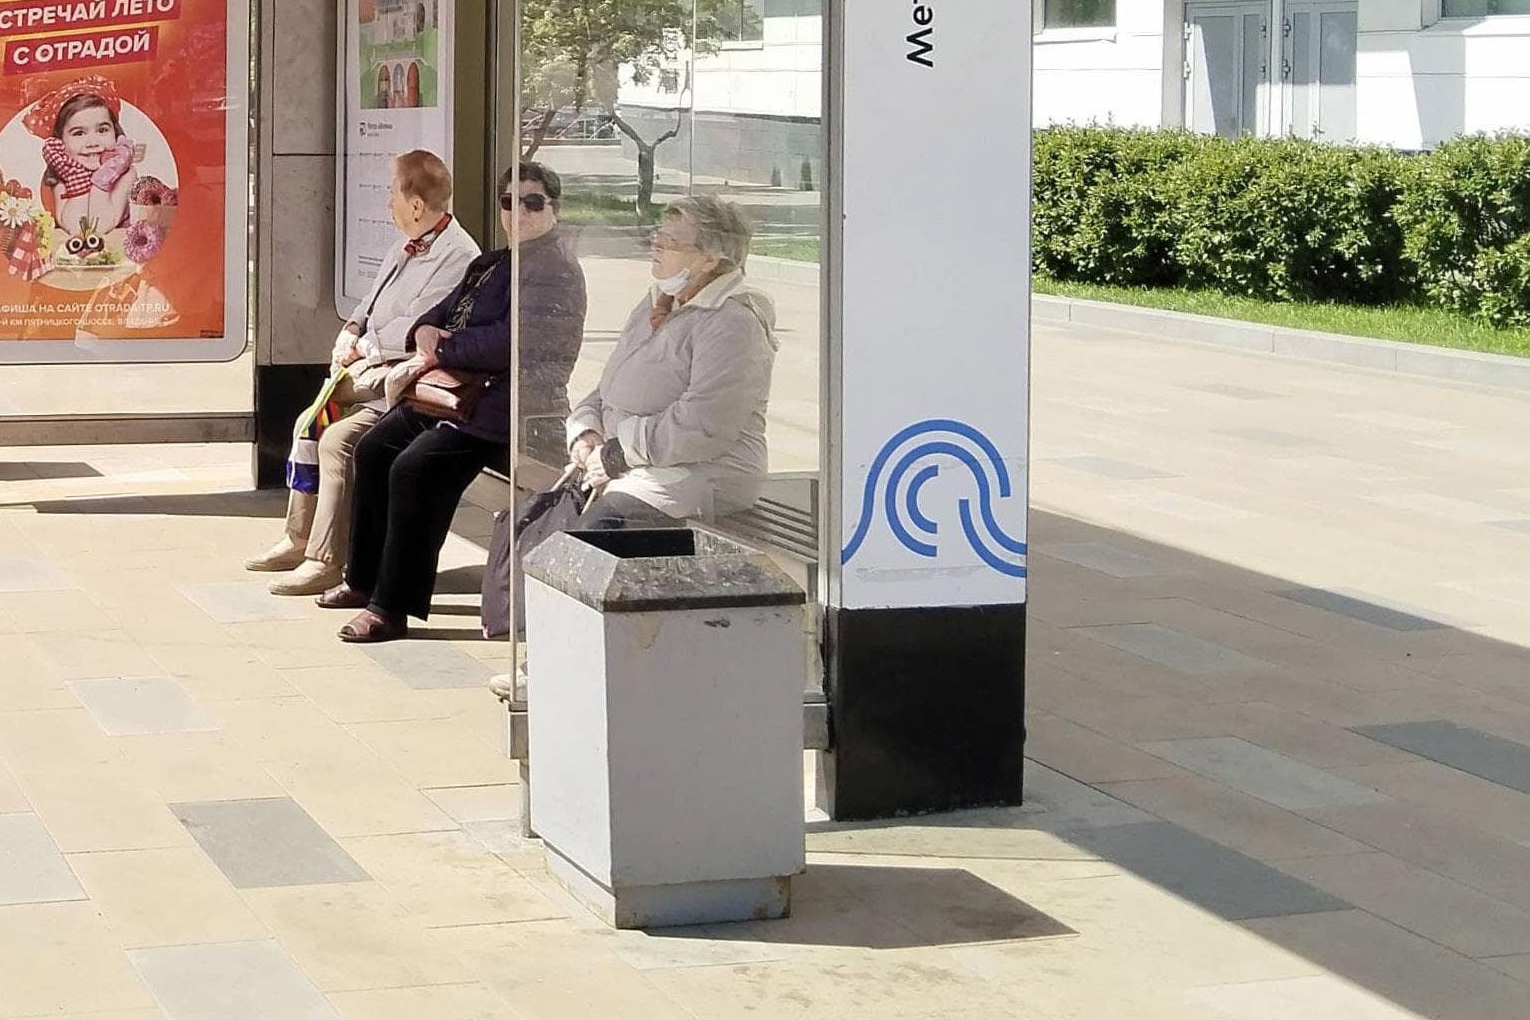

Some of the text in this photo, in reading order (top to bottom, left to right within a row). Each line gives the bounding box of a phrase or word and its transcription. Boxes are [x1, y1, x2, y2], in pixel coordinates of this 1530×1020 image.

[13, 30, 150, 65] С ОТРАДОЙ
[38, 303, 55, 313] НА
[57, 301, 93, 313] САЙТЕ
[24, 318, 82, 327] ПЯТНИЦКОГО
